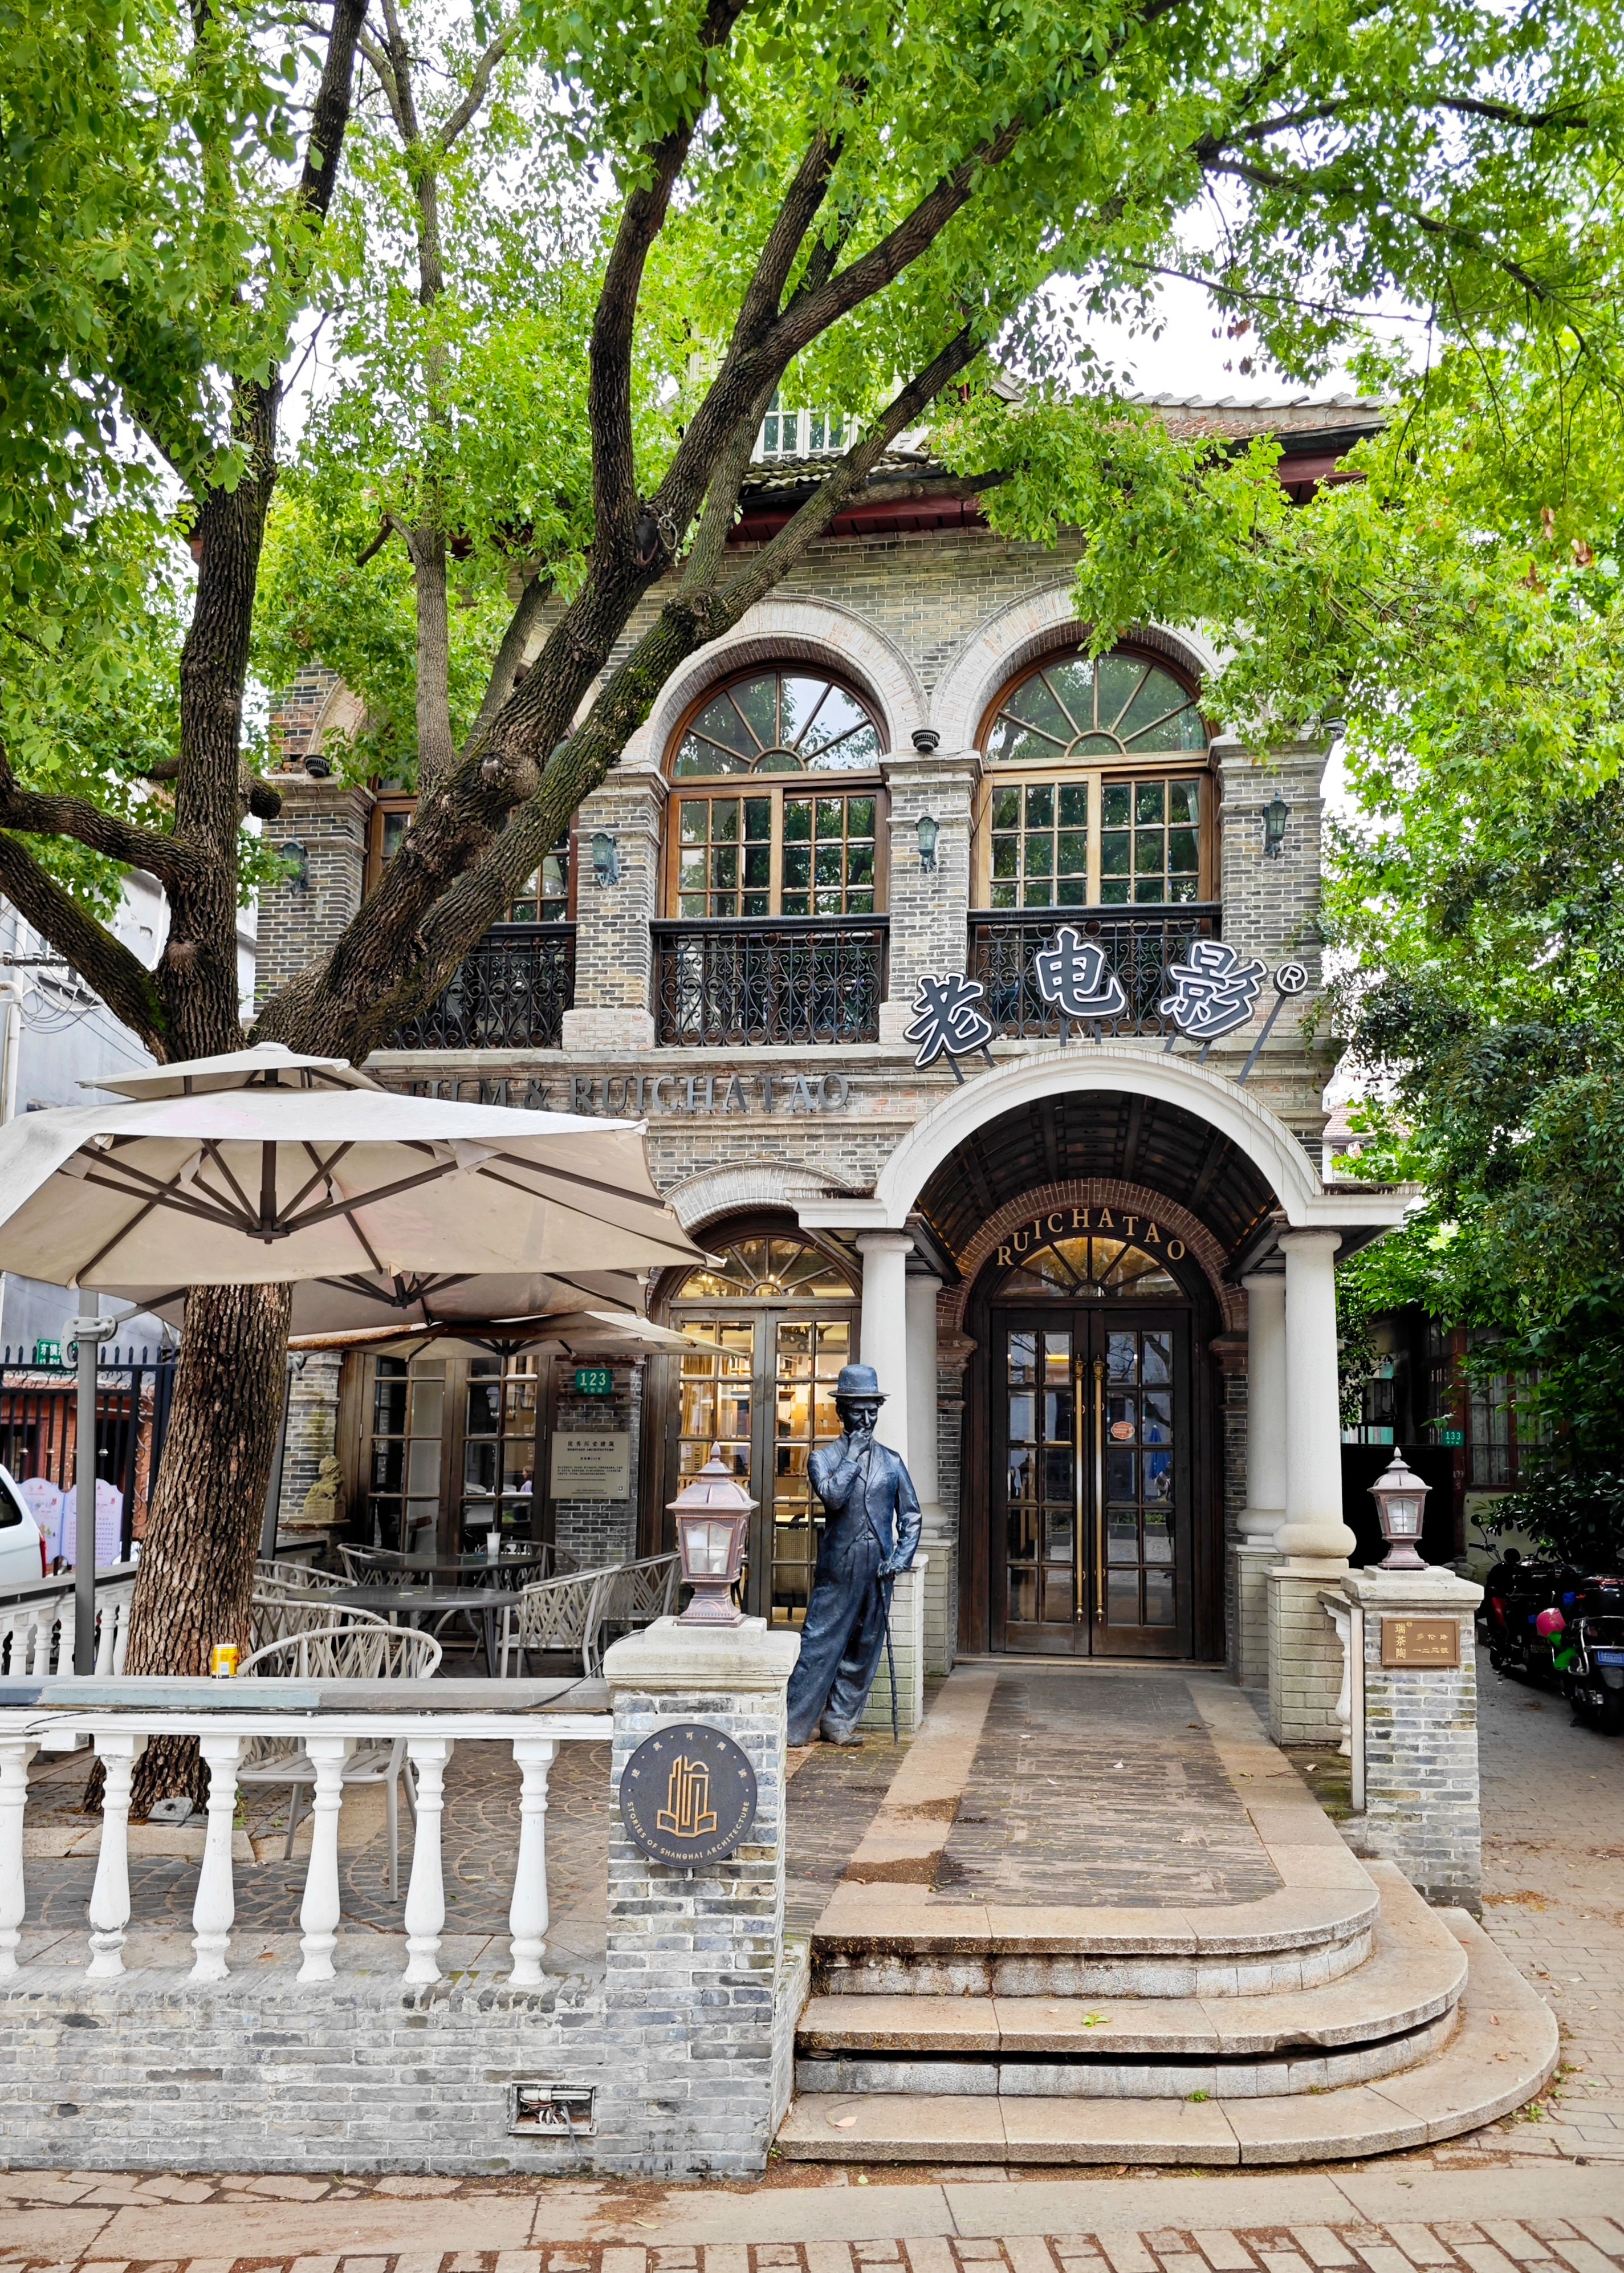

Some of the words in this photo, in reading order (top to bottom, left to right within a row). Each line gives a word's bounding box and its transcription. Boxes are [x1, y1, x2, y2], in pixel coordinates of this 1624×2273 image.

[570, 1072, 849, 1113] RUICHATAO
[996, 1207, 1185, 1266] RUICHATAO
[580, 1372, 606, 1386] 123
[1446, 1432, 1460, 1440] 133
[628, 1802, 646, 1838] STORIES
[647, 1839, 658, 1848] OF
[660, 1848, 703, 1860] SHANGHAI
[707, 1802, 750, 1856] ARCHITECTURE
